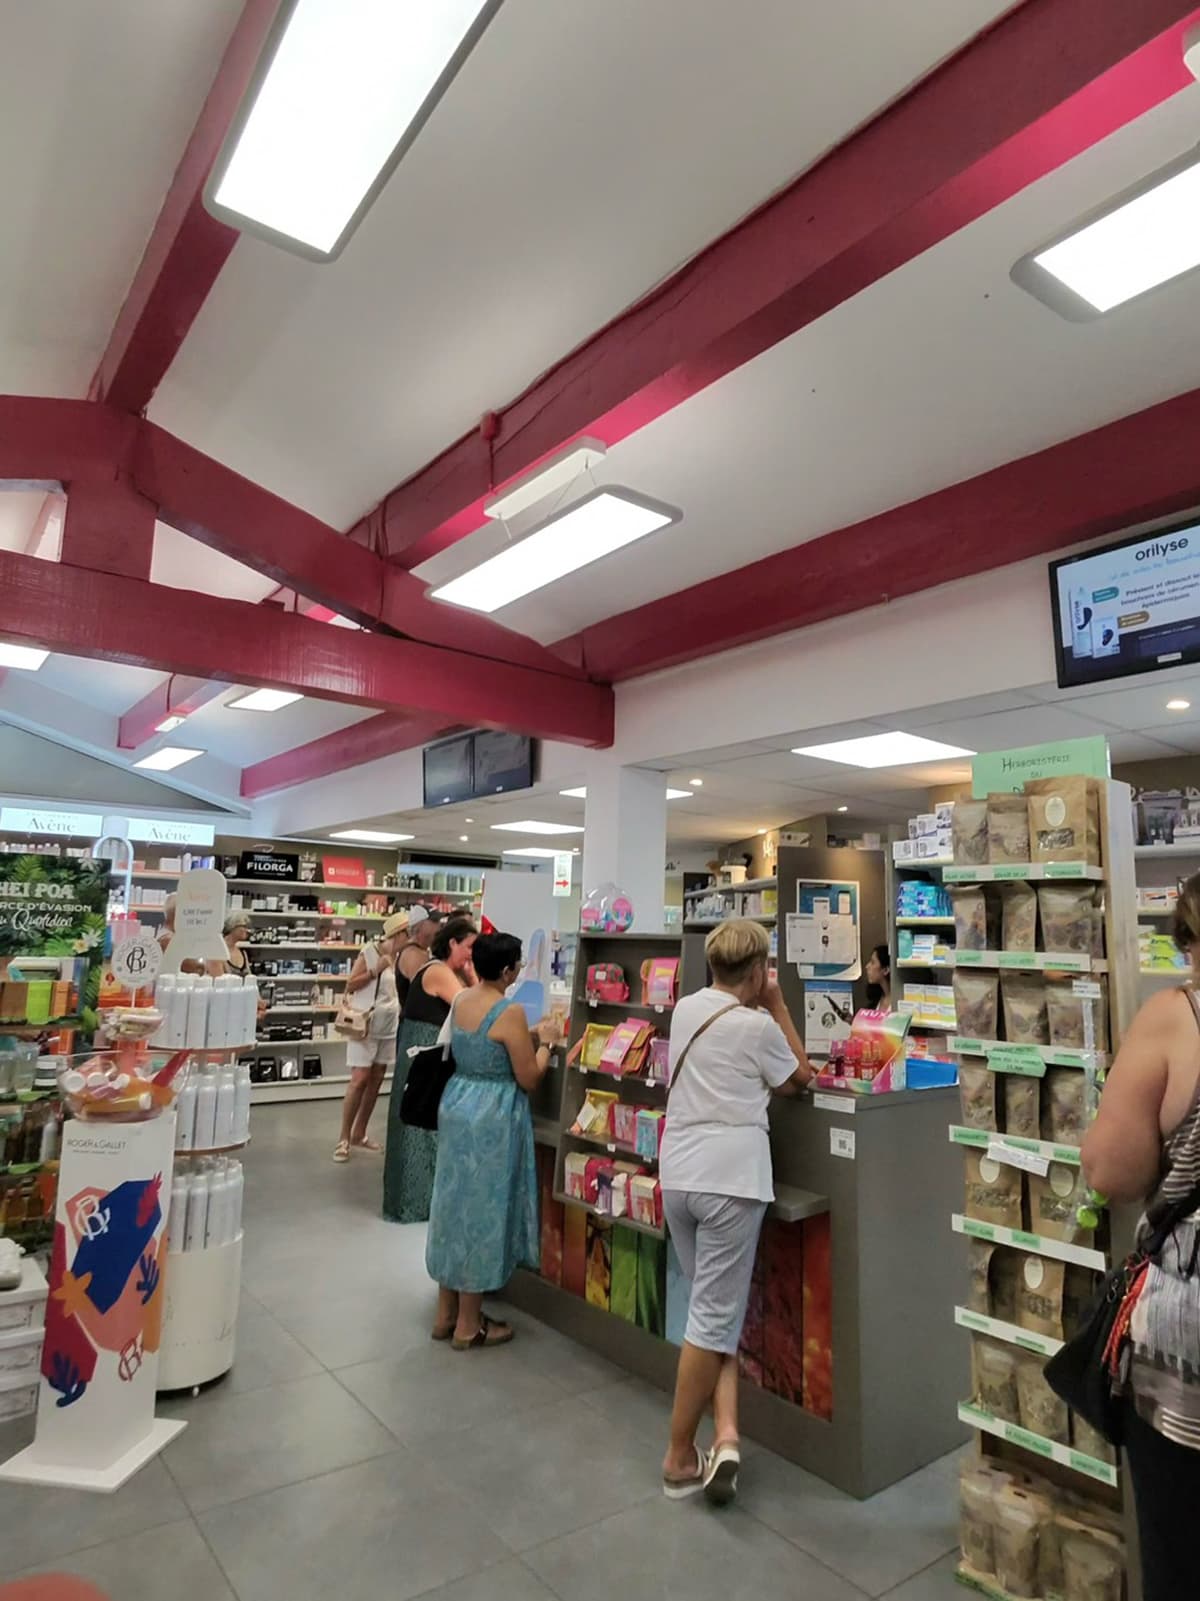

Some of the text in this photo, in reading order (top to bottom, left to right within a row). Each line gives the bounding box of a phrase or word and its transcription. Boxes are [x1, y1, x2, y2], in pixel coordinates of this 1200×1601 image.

[1135, 538, 1189, 561] orilyse
[29, 817, 77, 833] Avène
[148, 827, 192, 841] Avène
[246, 861, 293, 873] FILORGA
[34, 883, 76, 899] POA
[860, 1010, 890, 1018] NUX
